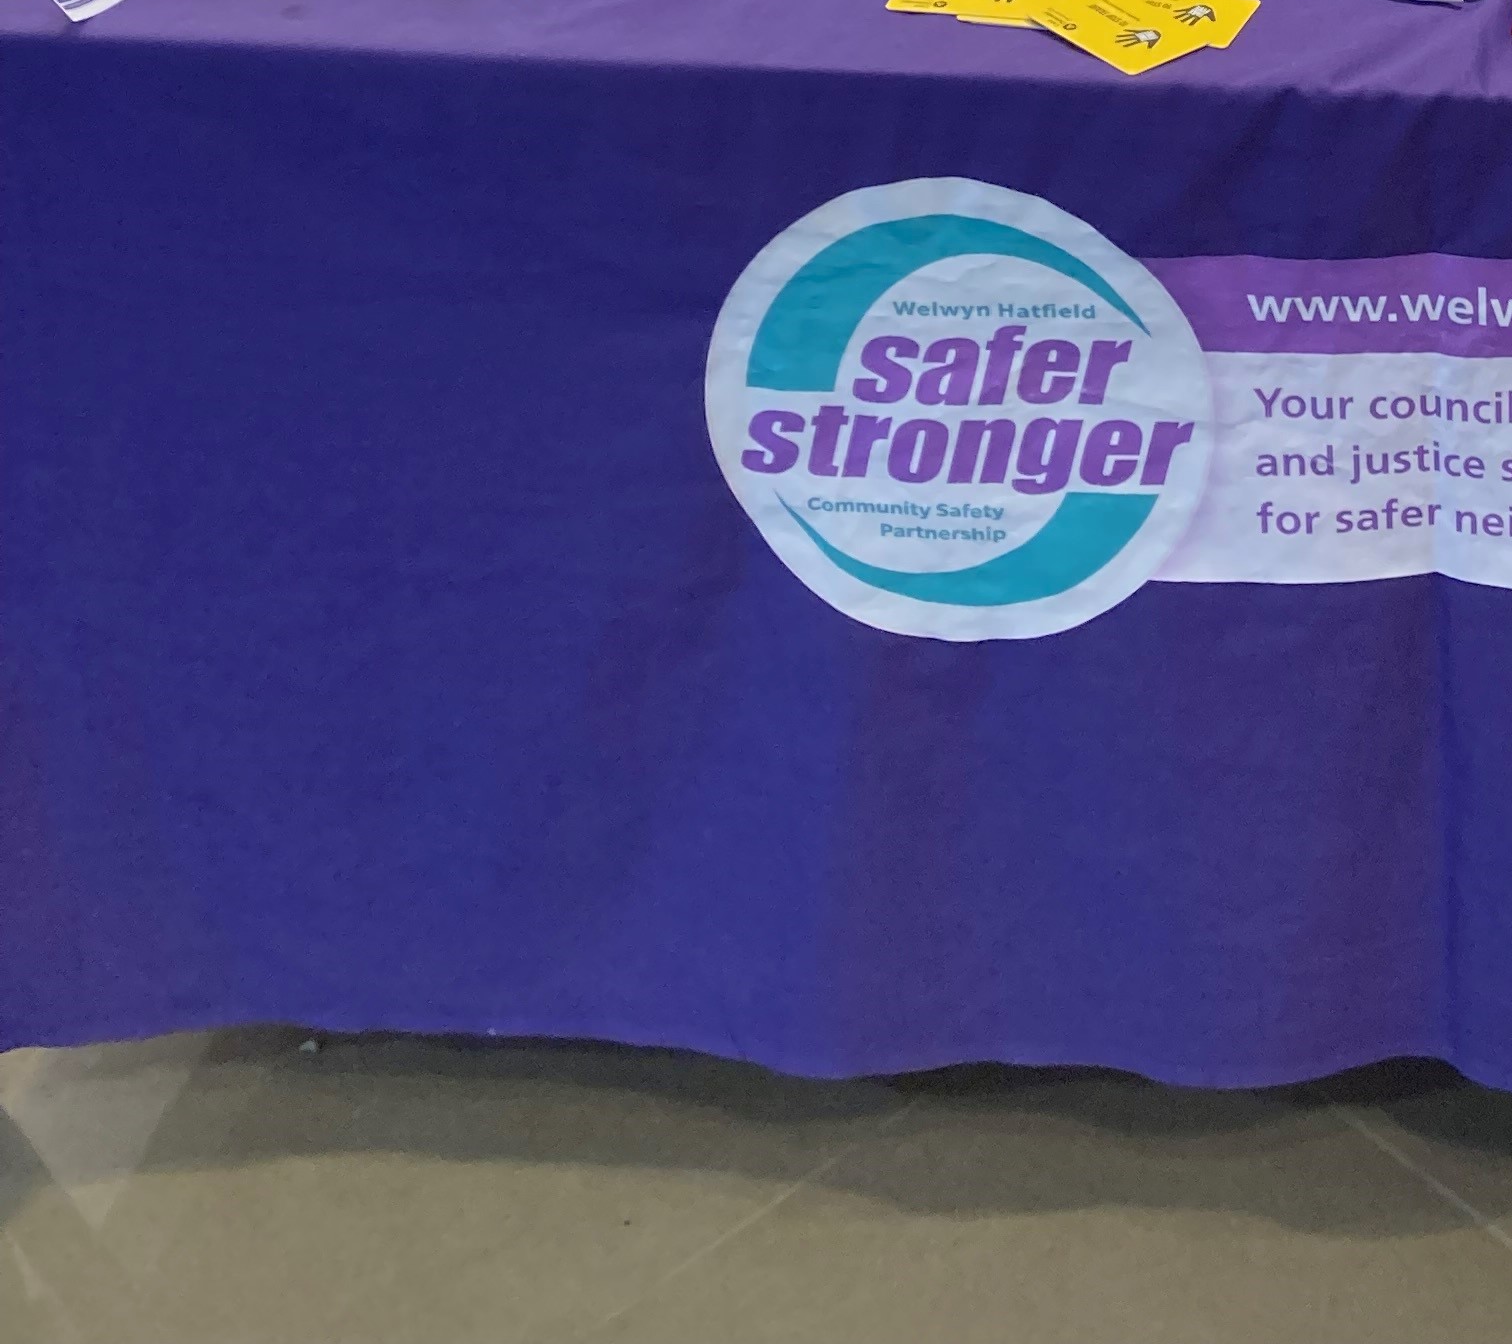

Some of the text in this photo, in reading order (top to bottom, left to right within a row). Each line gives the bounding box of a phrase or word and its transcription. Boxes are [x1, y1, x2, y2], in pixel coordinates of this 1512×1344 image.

[893, 300, 1096, 320] Welwyn Hatfield
[852, 325, 1132, 405] safer
[1253, 387, 1354, 420] Your
[741, 405, 1195, 495] stronger
[1255, 445, 1335, 477] and
[1350, 441, 1486, 484] justice
[807, 496, 1005, 520] Community Safety
[1256, 501, 1320, 536] for
[1335, 499, 1443, 534] safer
[879, 523, 1008, 543] Partnership
